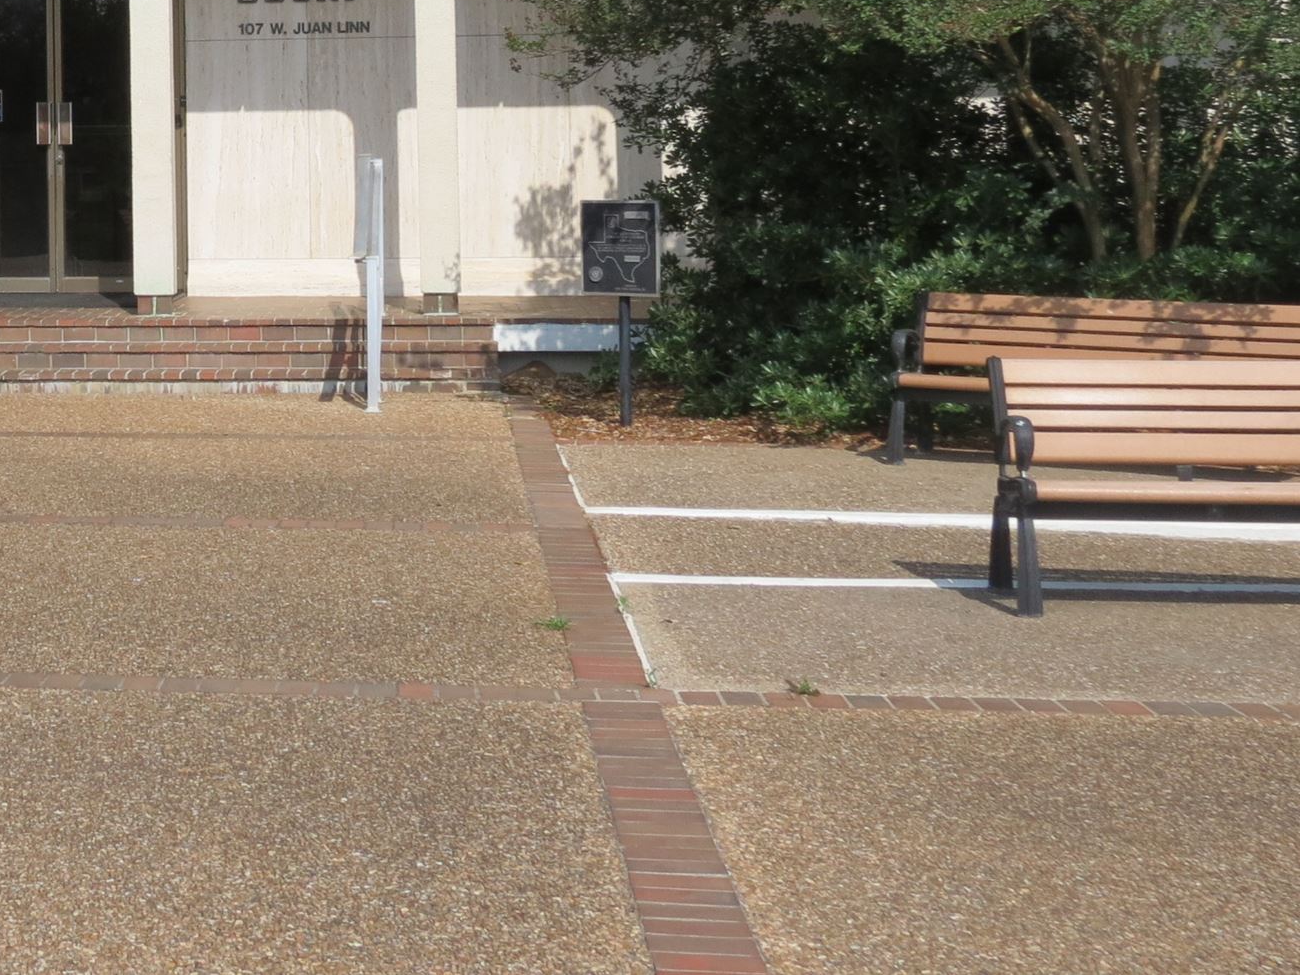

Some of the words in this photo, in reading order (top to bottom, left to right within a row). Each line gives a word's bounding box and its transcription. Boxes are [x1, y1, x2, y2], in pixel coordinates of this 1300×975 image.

[238, 22, 264, 35] 107
[270, 22, 288, 35] W.
[293, 22, 332, 34] JUAN
[337, 21, 371, 34] LINN
